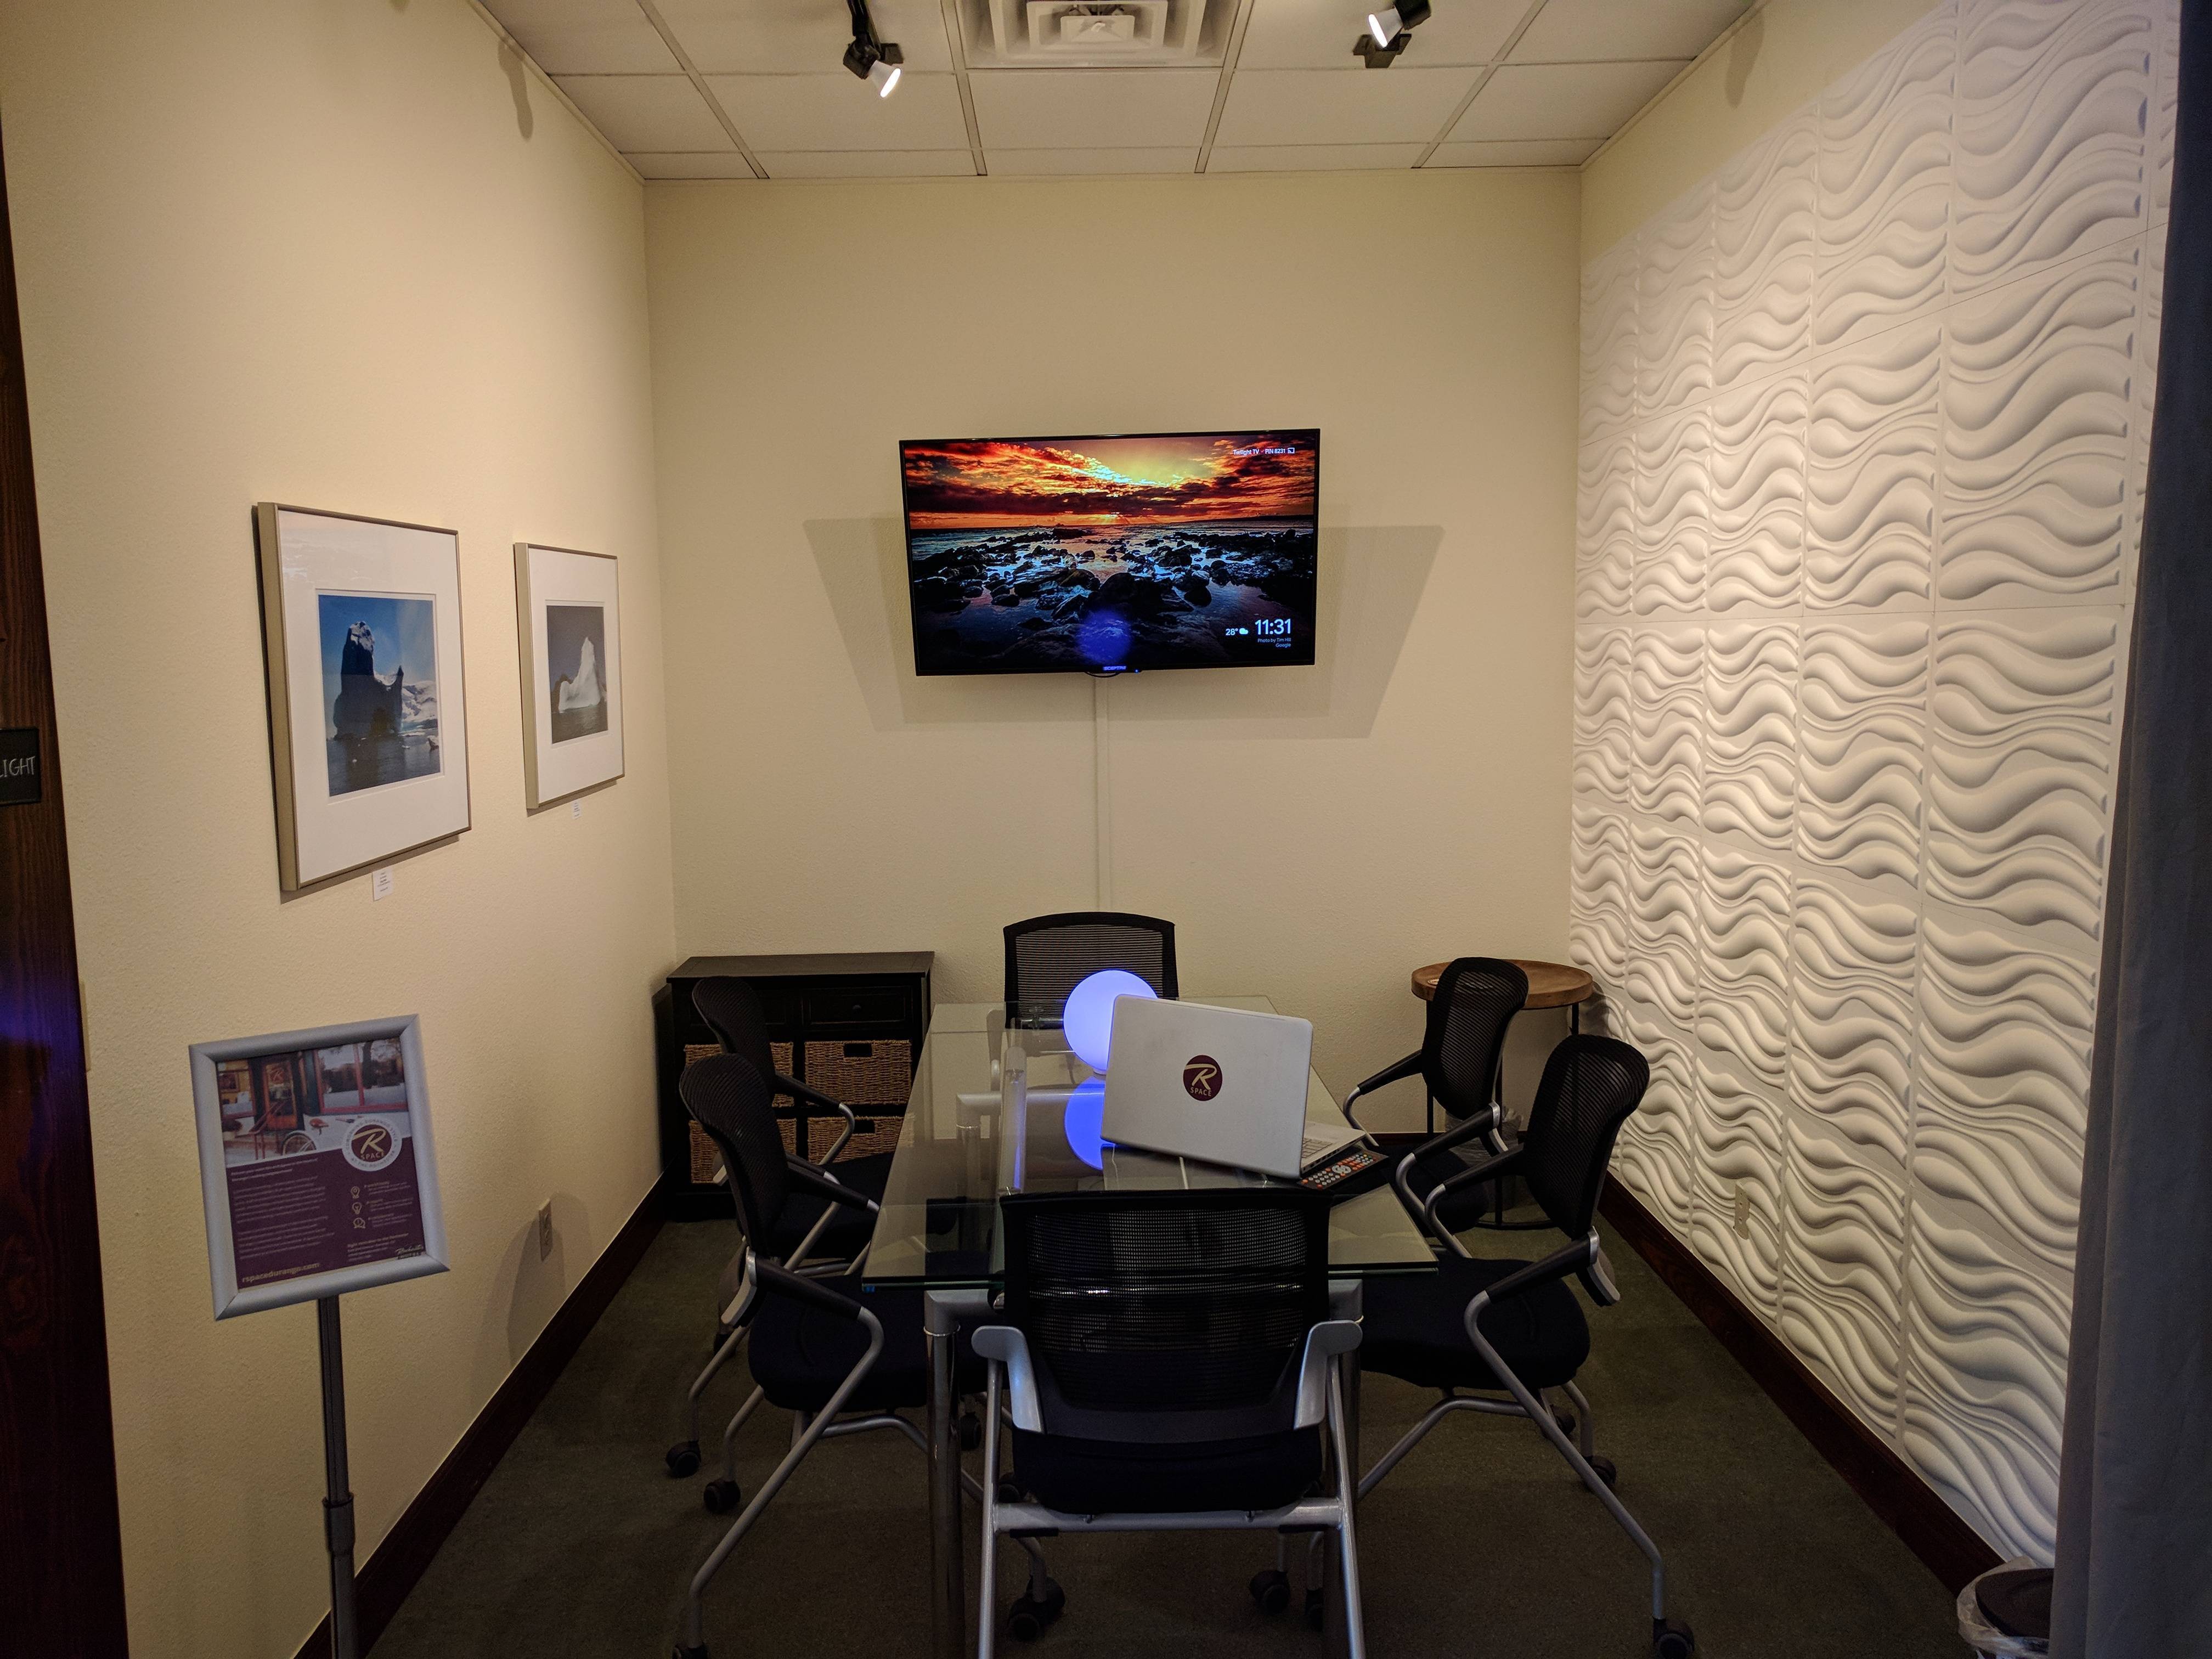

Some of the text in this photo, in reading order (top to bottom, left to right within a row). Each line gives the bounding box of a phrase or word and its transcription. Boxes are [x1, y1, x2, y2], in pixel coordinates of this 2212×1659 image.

[1255, 618, 1291, 635] 11:31
[0, 756, 36, 777] IGHT
[1190, 1087, 1212, 1097] SPACE
